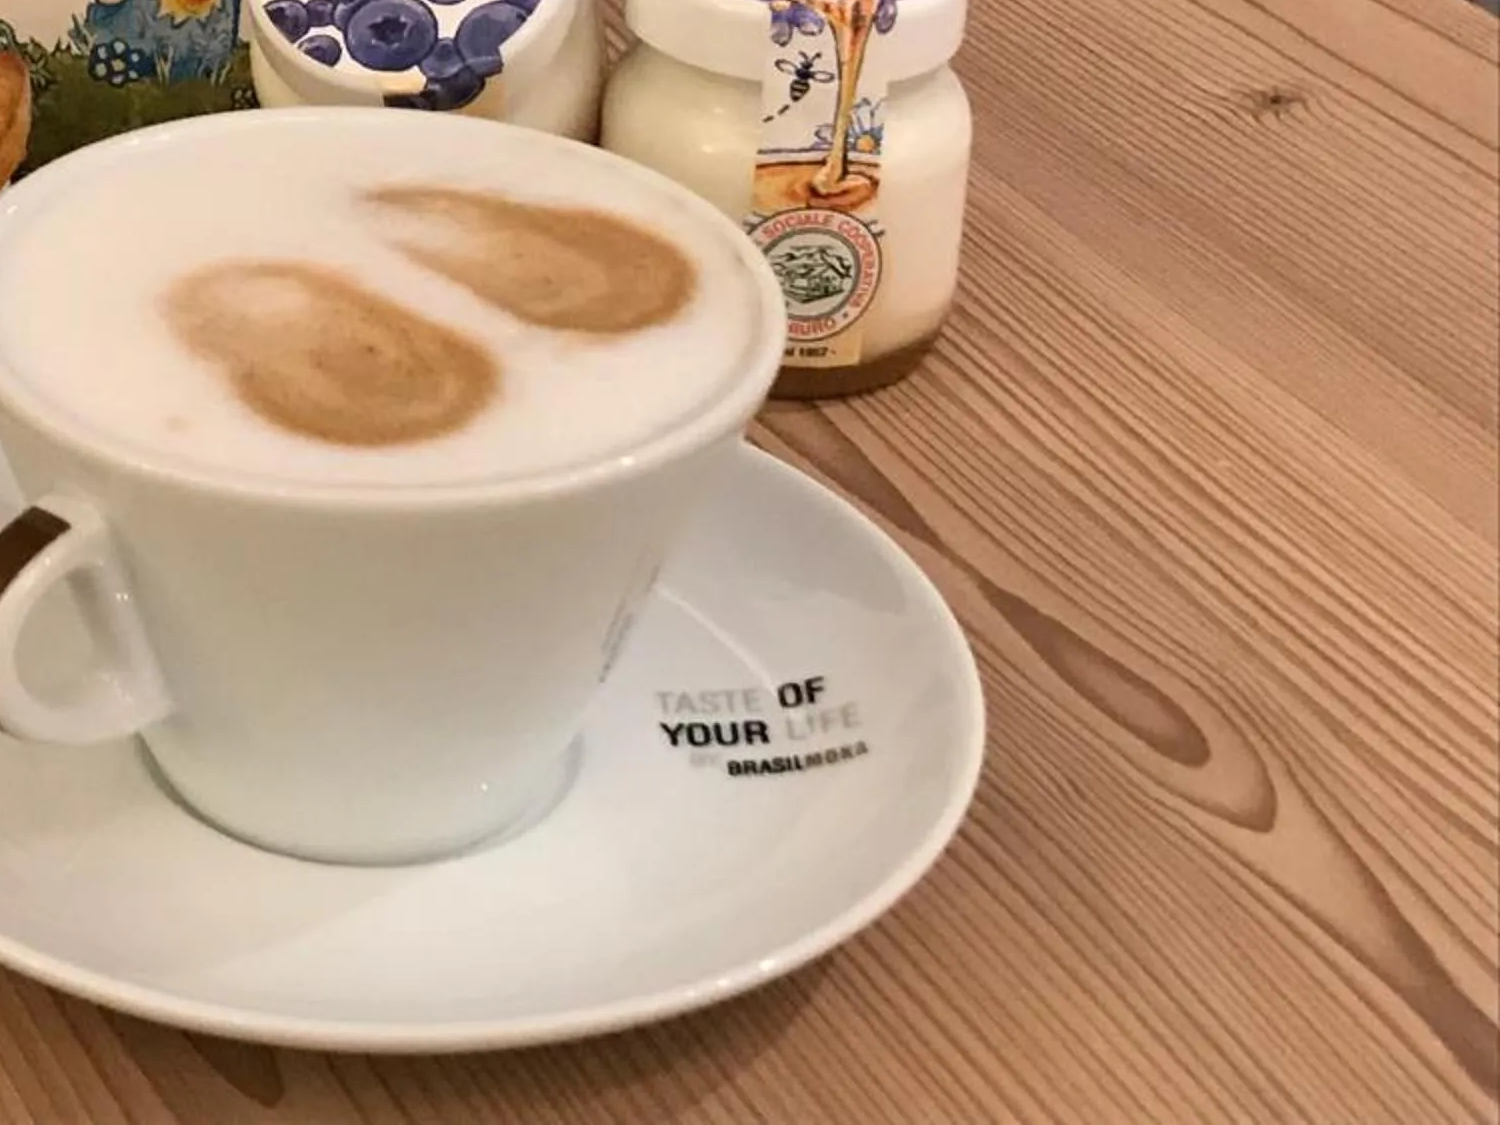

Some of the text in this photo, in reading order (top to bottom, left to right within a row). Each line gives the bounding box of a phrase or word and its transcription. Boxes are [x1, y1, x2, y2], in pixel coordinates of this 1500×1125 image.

[655, 676, 825, 715] TASTE OF
[659, 701, 863, 748] YOUR LIFE
